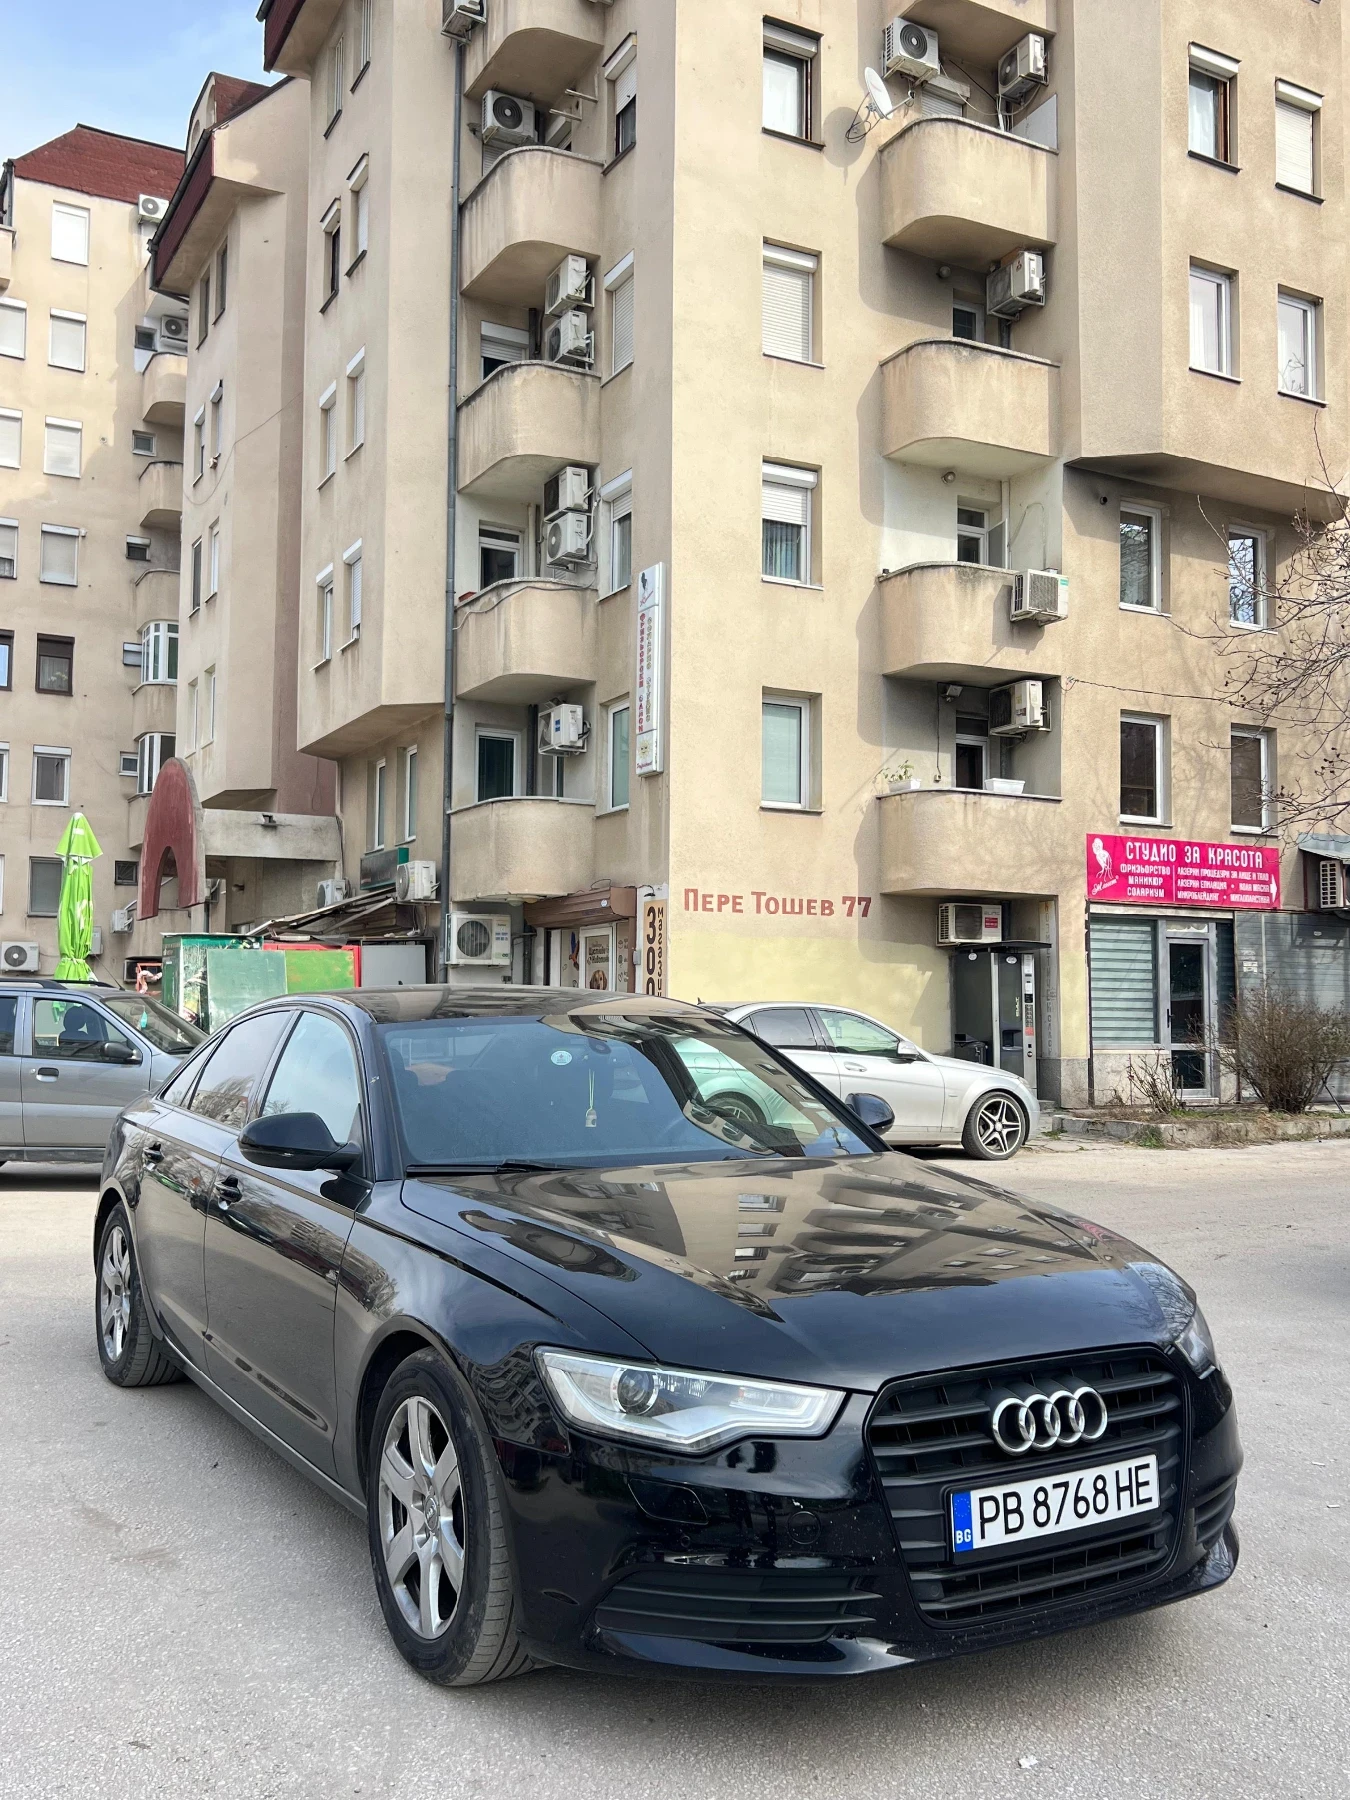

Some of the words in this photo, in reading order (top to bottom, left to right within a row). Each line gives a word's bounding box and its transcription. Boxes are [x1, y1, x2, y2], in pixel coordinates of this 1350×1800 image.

[1126, 841, 1176, 862] СТУДИО
[1184, 845, 1200, 863] ЗА
[1208, 847, 1263, 868] КРАСОТА
[1120, 863, 1171, 875] ФРИЗЬОРСТВО
[1128, 875, 1164, 886] МАНИКЮР
[1127, 887, 1165, 898] СОЛАРИУМ
[684, 888, 744, 914] ПЕРЕ
[750, 891, 835, 917] ТОШЕВ
[841, 895, 872, 918] 77
[978, 1491, 1024, 1540] PB
[1033, 1473, 1109, 1528] 8768
[1115, 1463, 1153, 1511] HE
[955, 1528, 972, 1544] BG
